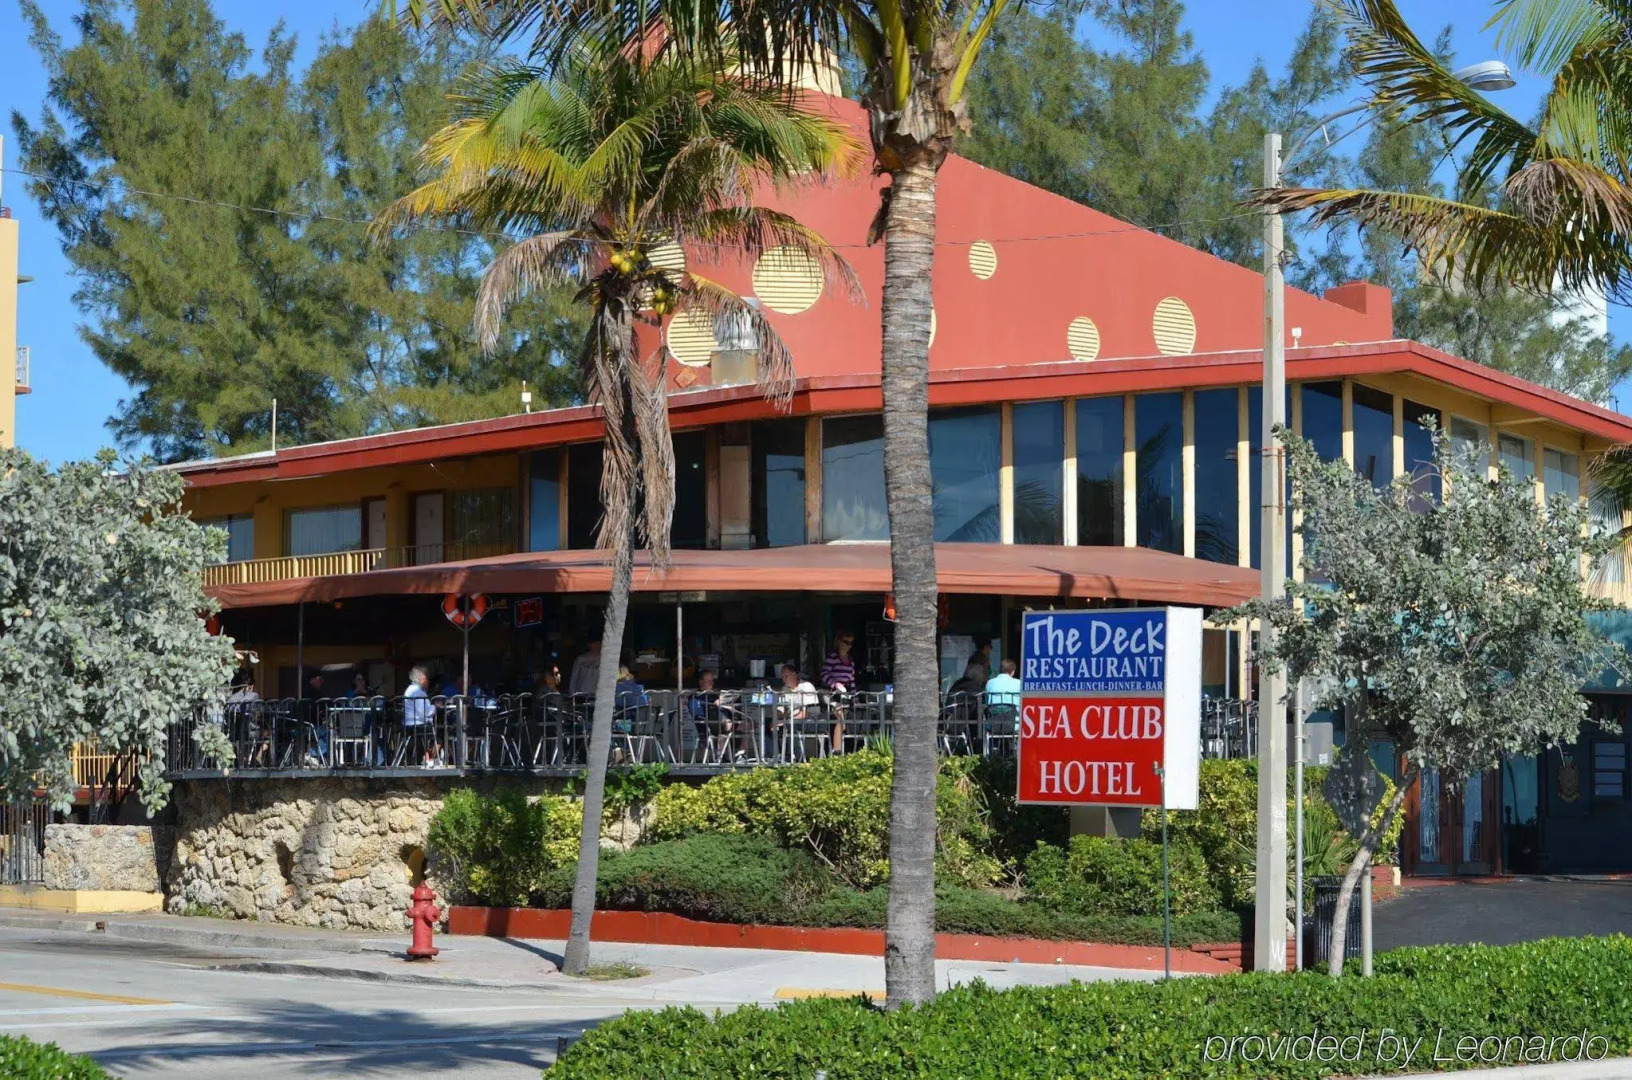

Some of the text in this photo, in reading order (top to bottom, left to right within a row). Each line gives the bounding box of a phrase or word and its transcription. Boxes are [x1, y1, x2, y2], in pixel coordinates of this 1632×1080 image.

[1027, 616, 1164, 656] The Deck
[1026, 656, 1162, 678] RESTAURANT
[1024, 681, 1163, 691] BREAKFAST-LUNCH-DINNER-BAR
[1022, 705, 1162, 739] SEA CLUB
[1038, 760, 1141, 796] HOTEL
